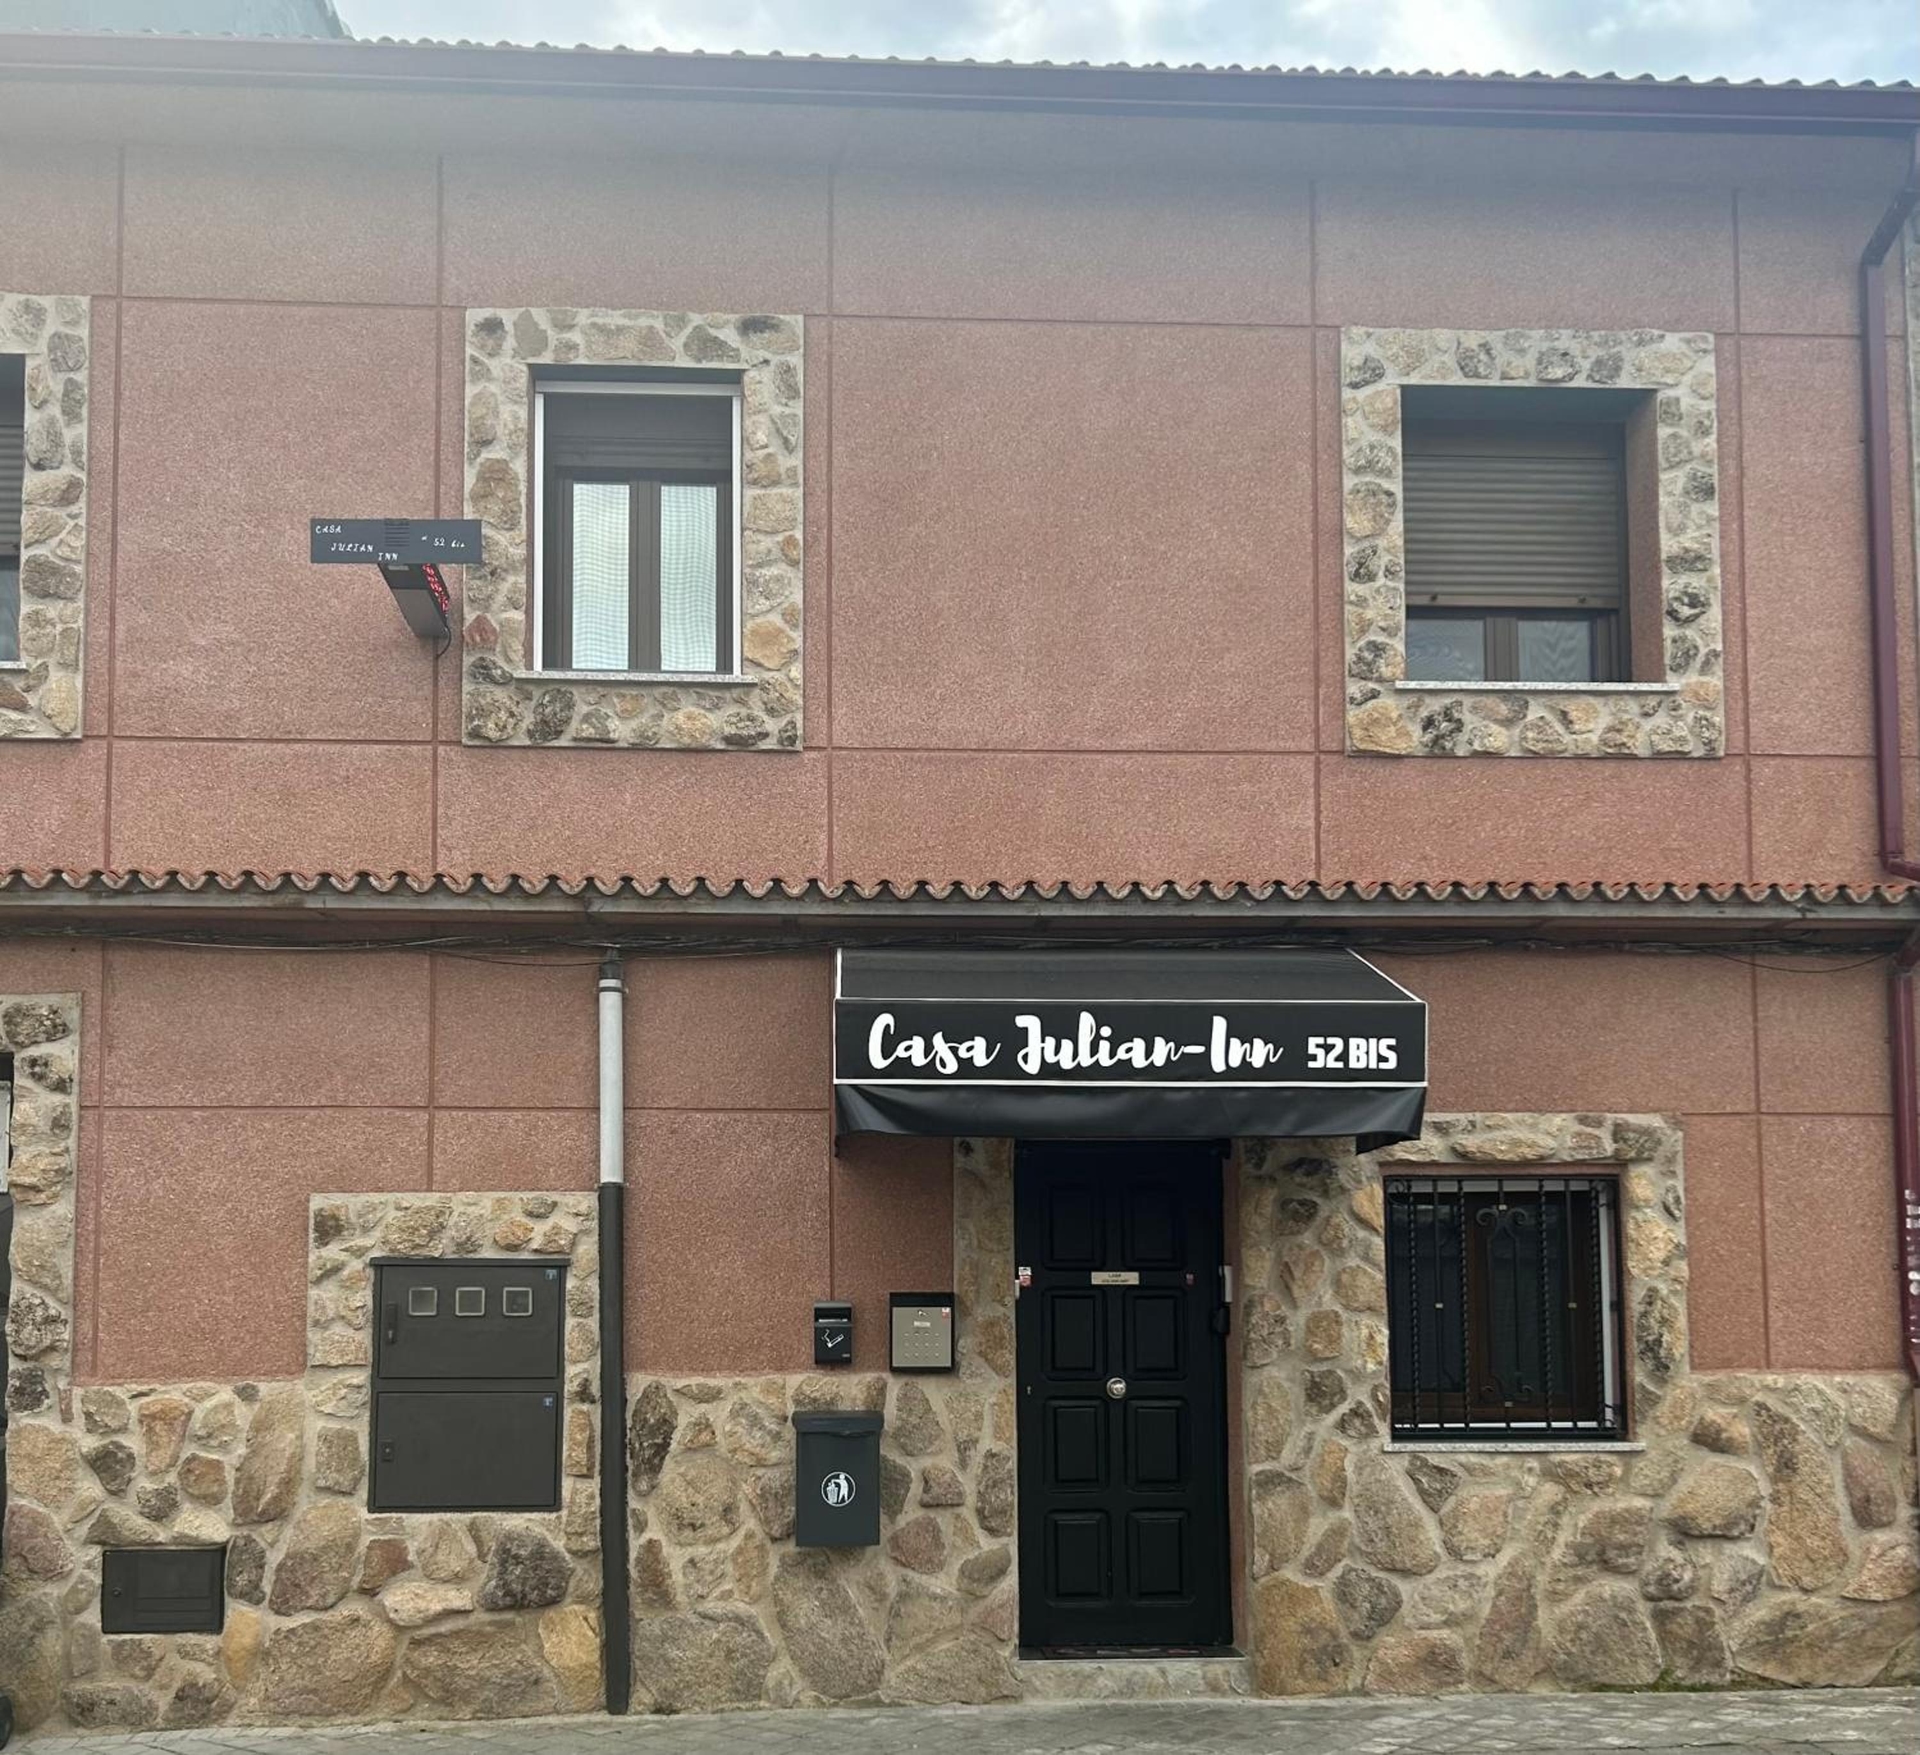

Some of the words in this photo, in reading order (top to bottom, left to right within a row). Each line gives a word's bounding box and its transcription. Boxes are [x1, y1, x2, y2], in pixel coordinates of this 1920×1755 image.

[315, 524, 342, 534] CASA
[433, 537, 445, 547] 52
[330, 542, 374, 553] JULIAN
[377, 552, 399, 561] INN
[868, 1012, 1001, 1075] Casa
[1015, 1010, 1284, 1074] Julian-Inn
